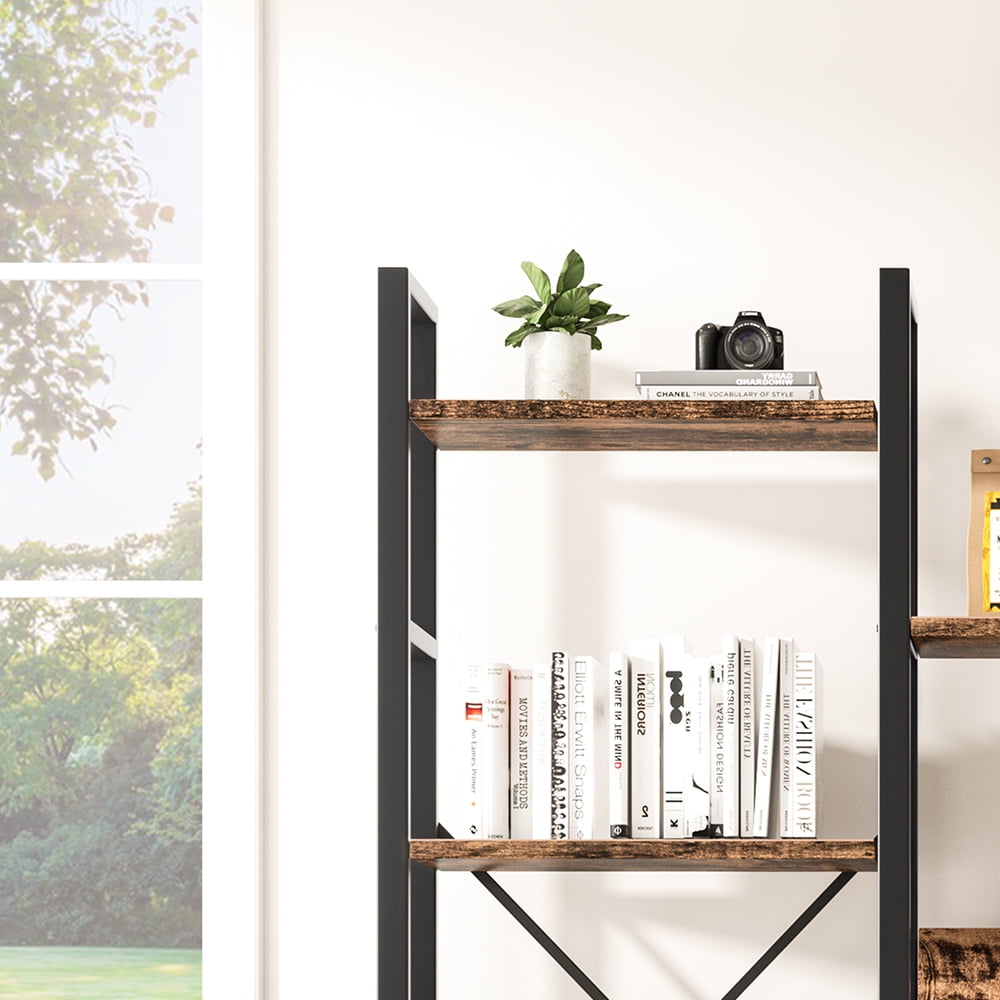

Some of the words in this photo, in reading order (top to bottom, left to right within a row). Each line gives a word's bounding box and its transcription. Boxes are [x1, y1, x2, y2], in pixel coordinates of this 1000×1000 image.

[574, 660, 587, 704] Elliott
[471, 728, 478, 740] An
[520, 698, 528, 737] MOVIES
[574, 712, 587, 757] Erwitt
[520, 740, 528, 761] AND
[520, 762, 528, 810] METHODS
[572, 764, 587, 820] Snaps
